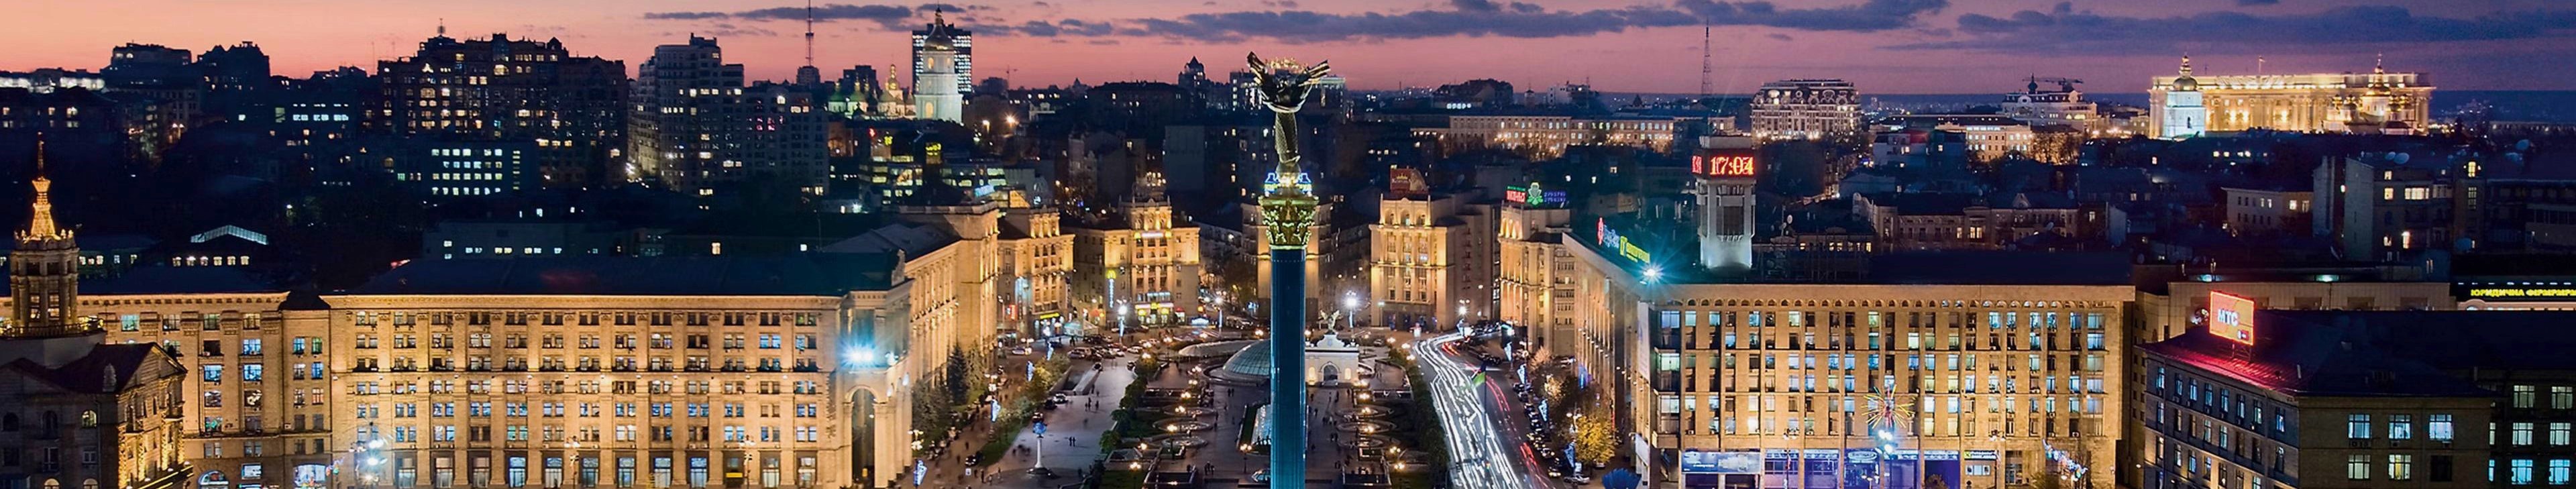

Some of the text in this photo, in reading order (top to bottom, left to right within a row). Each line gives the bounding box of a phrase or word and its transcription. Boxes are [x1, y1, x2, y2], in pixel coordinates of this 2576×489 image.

[1710, 156, 1754, 175] 17:04
[2471, 289, 2524, 297] ЮРИДИЧНА
[2218, 309, 2239, 327] МТС
